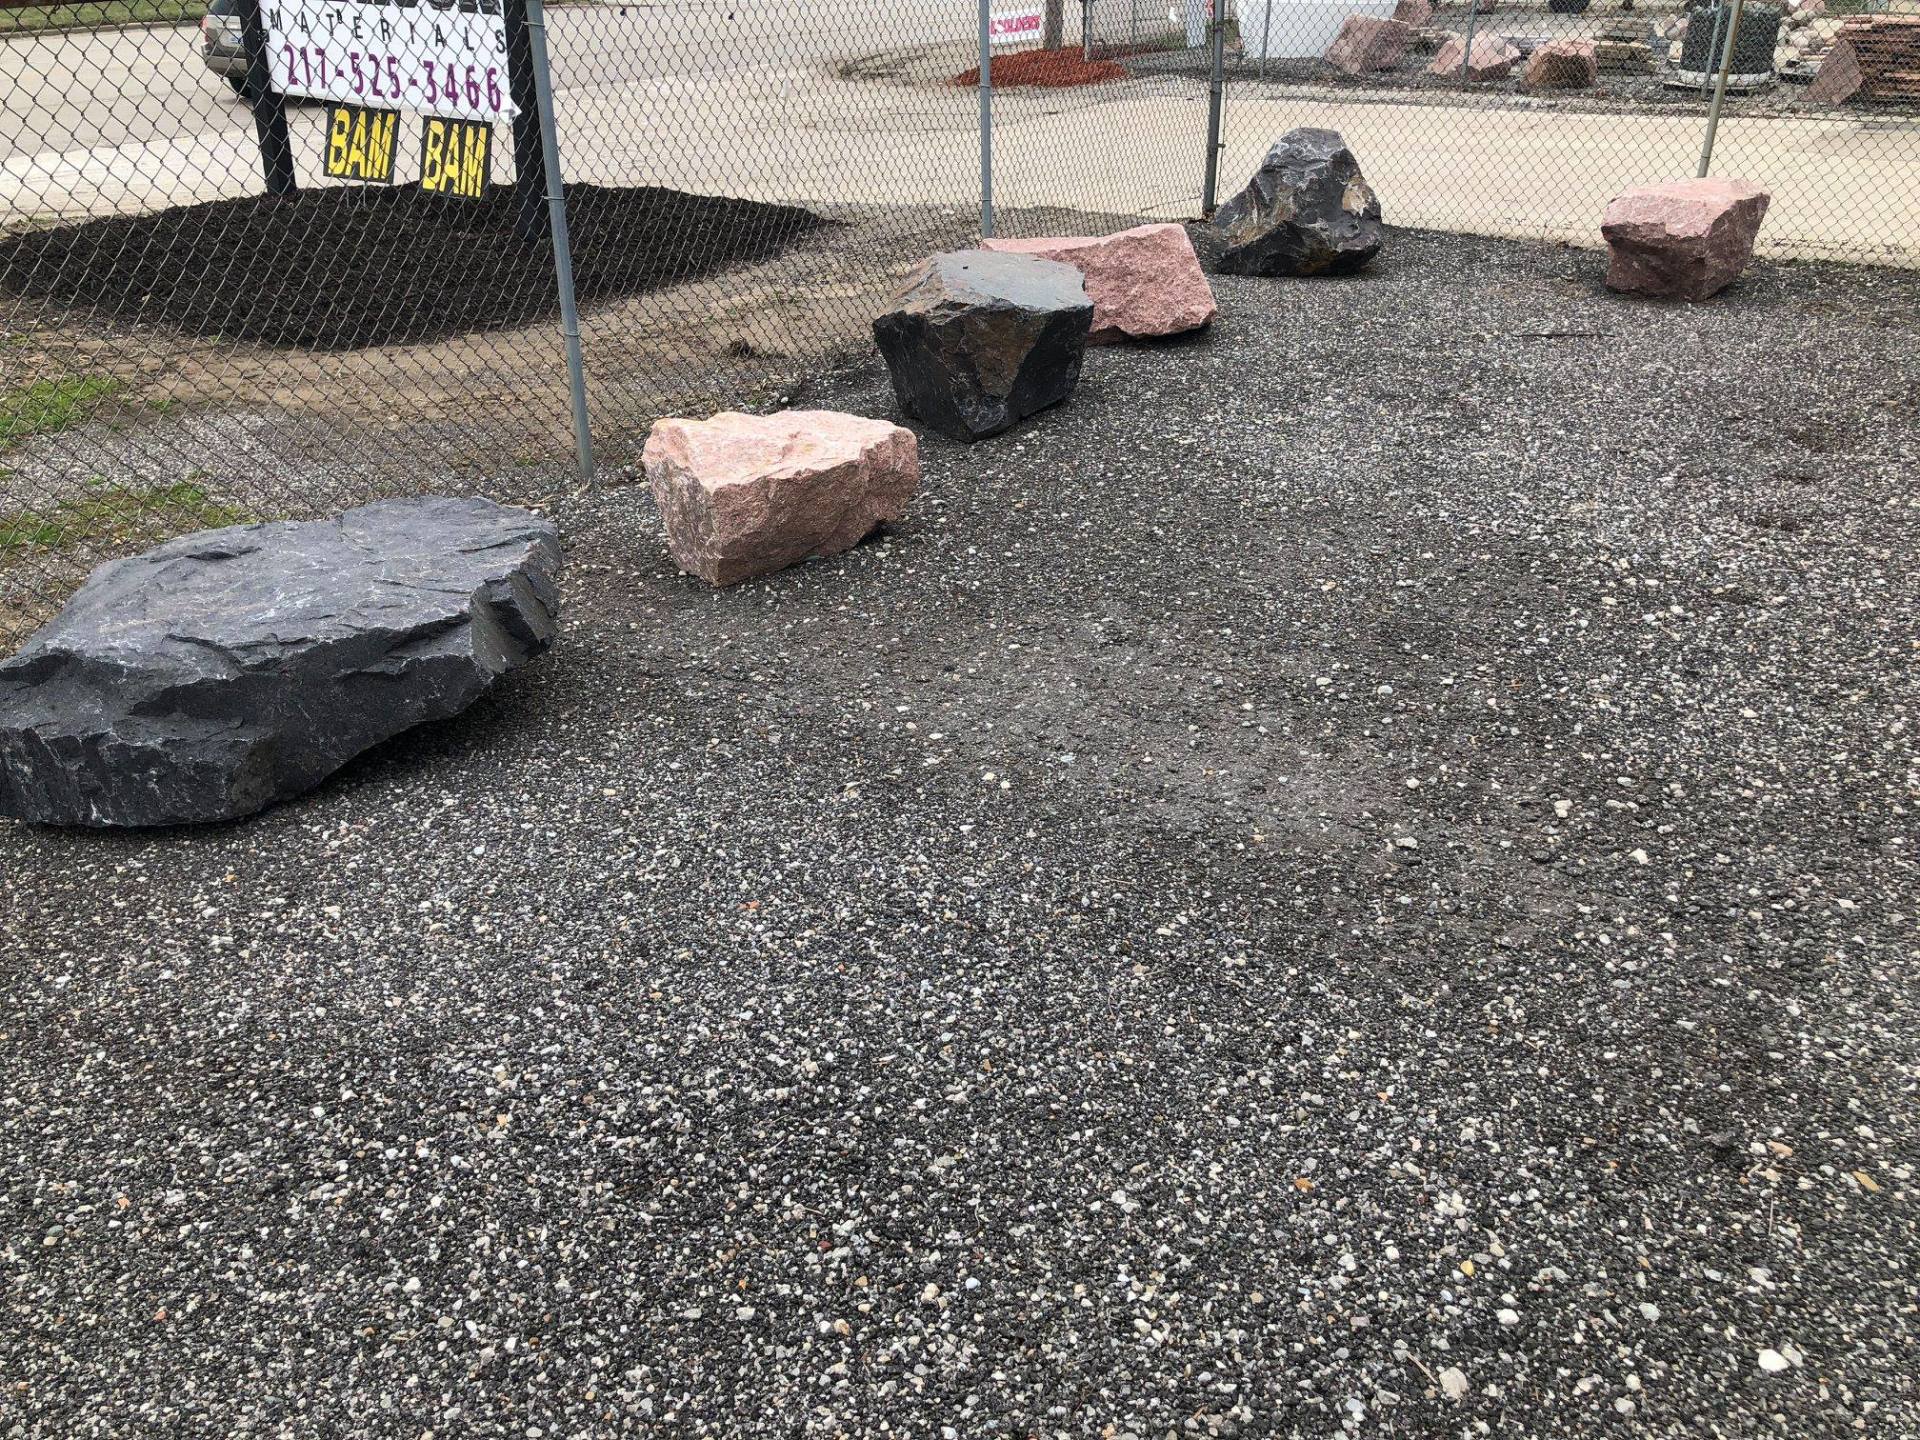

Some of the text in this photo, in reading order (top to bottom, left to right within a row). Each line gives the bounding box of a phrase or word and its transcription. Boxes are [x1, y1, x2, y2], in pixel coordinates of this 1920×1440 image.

[270, 8, 506, 54] MATERIALS
[284, 44, 501, 113] 217-525-3466
[327, 108, 395, 179] BAM
[422, 120, 487, 198] BAM
